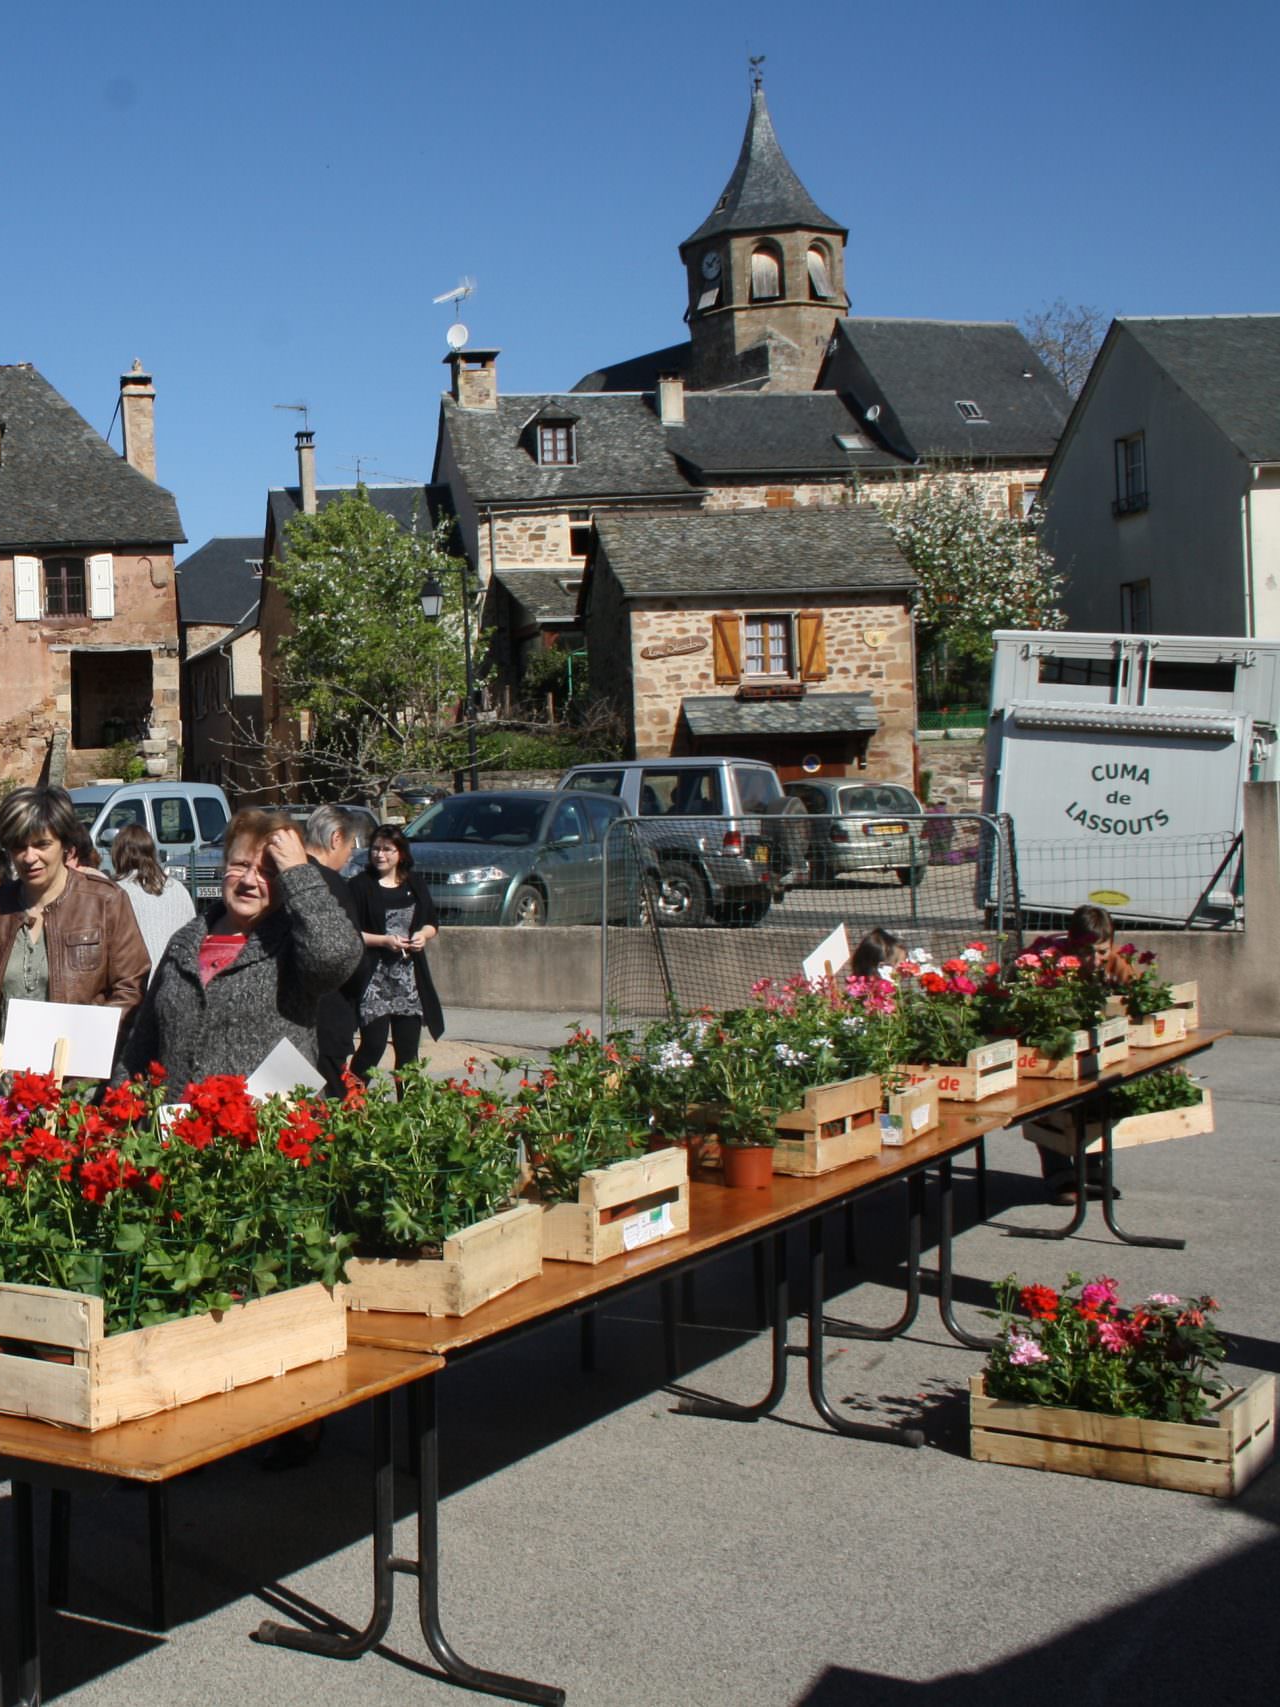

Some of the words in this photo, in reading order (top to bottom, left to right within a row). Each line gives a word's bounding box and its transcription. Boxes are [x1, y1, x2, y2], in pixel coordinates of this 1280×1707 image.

[1091, 763, 1151, 785] CUMA
[1106, 790, 1131, 805] de
[1065, 801, 1169, 835] LASSOUTS
[1017, 1054, 1038, 1068] de
[937, 1075, 960, 1091] de
